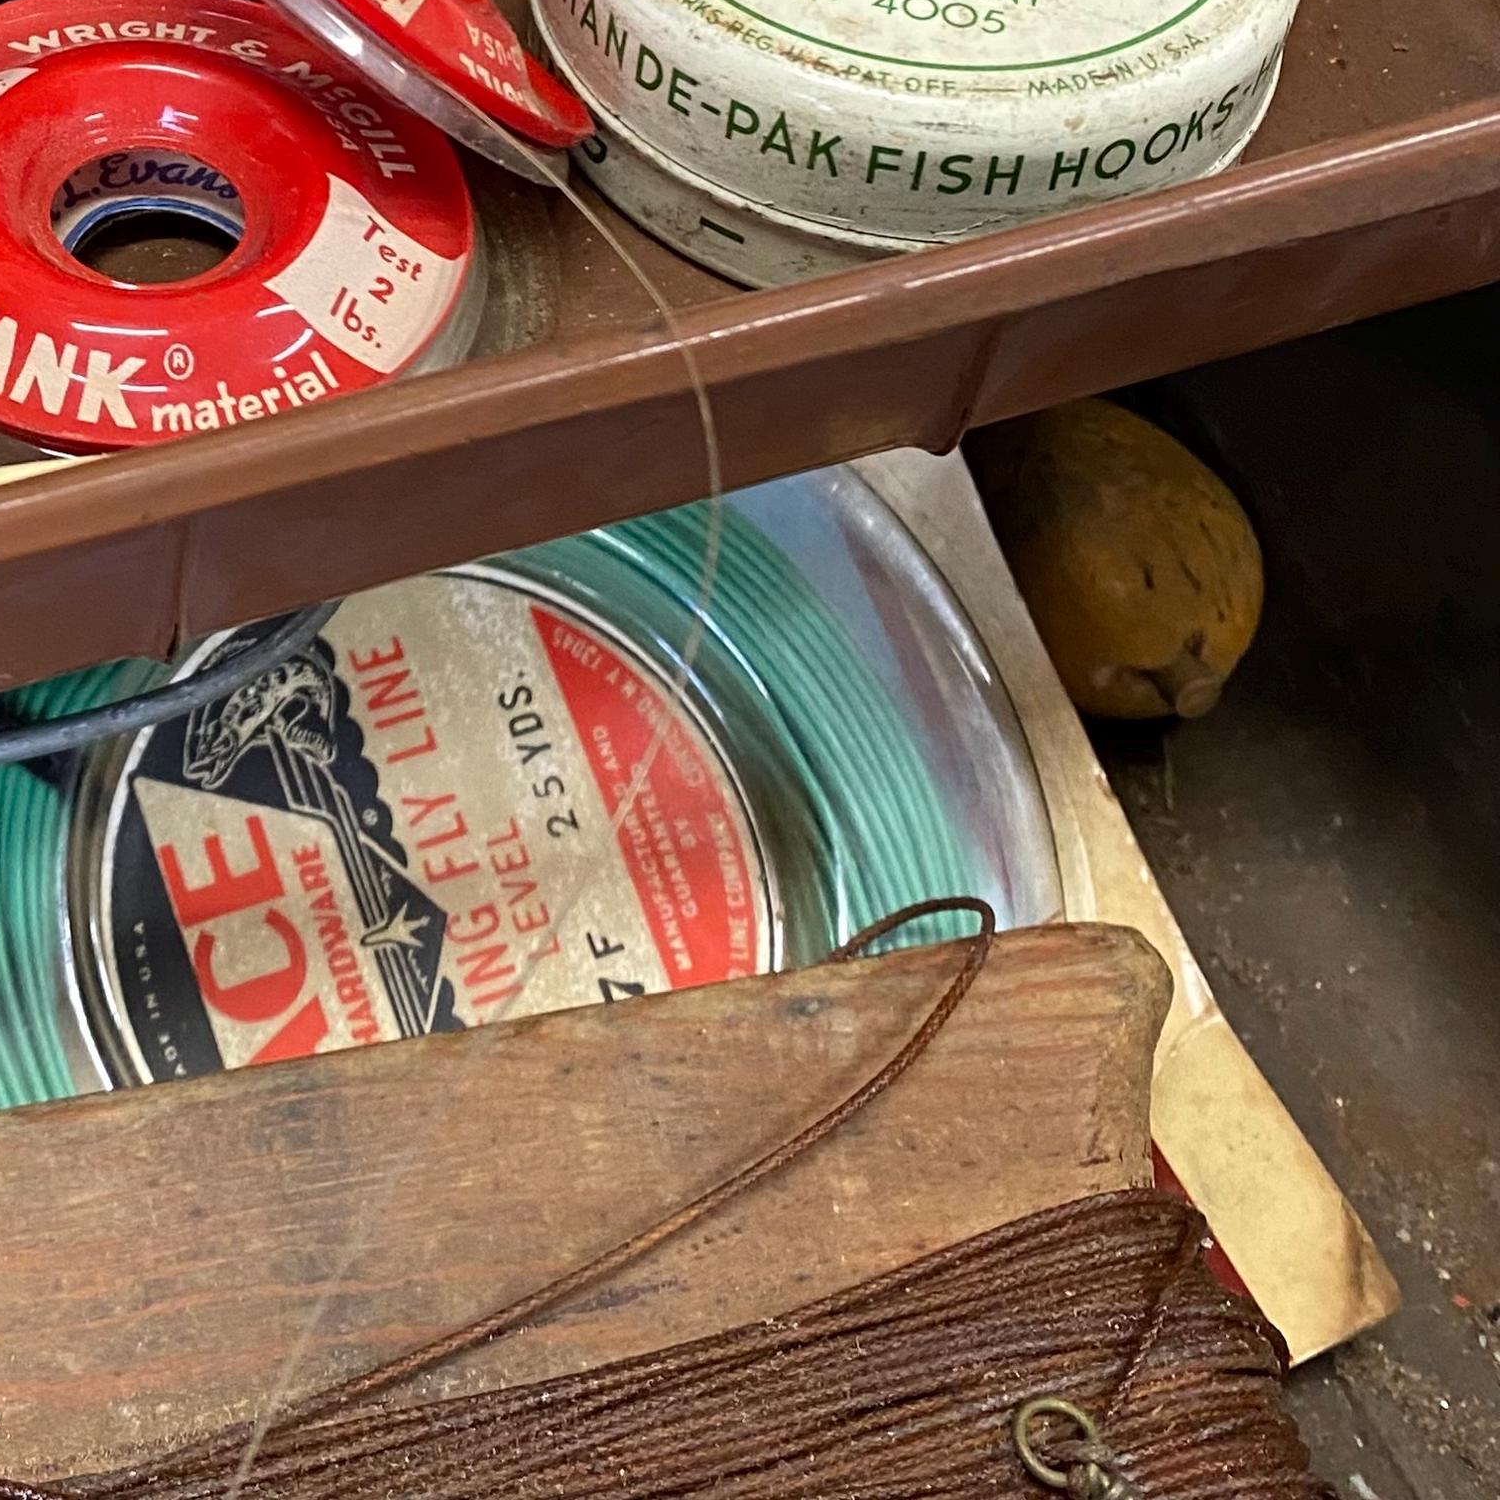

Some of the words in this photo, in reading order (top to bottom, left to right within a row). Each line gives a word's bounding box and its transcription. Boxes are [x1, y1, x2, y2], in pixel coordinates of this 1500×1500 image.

[8, 20, 218, 58] WRIGHT
[231, 39, 270, 62] &
[1027, 74, 1103, 98] MADE
[99, 153, 239, 199] Evans
[865, 145, 1024, 196] FISH
[364, 215, 423, 281] Test
[369, 275, 396, 304] 2
[329, 287, 384, 350] lbs.
[152, 351, 340, 434] material
[347, 634, 438, 765] LINE
[591, 725, 620, 773] AND
[400, 791, 480, 885] FLY
[673, 817, 699, 850] BY
[705, 811, 747, 909] COMPANY
[486, 816, 562, 963] LEVEL
[291, 842, 380, 1045] HARDWARE
[444, 903, 526, 1009] ING
[727, 916, 752, 963] LINE
[157, 1032, 188, 1077] ADE
